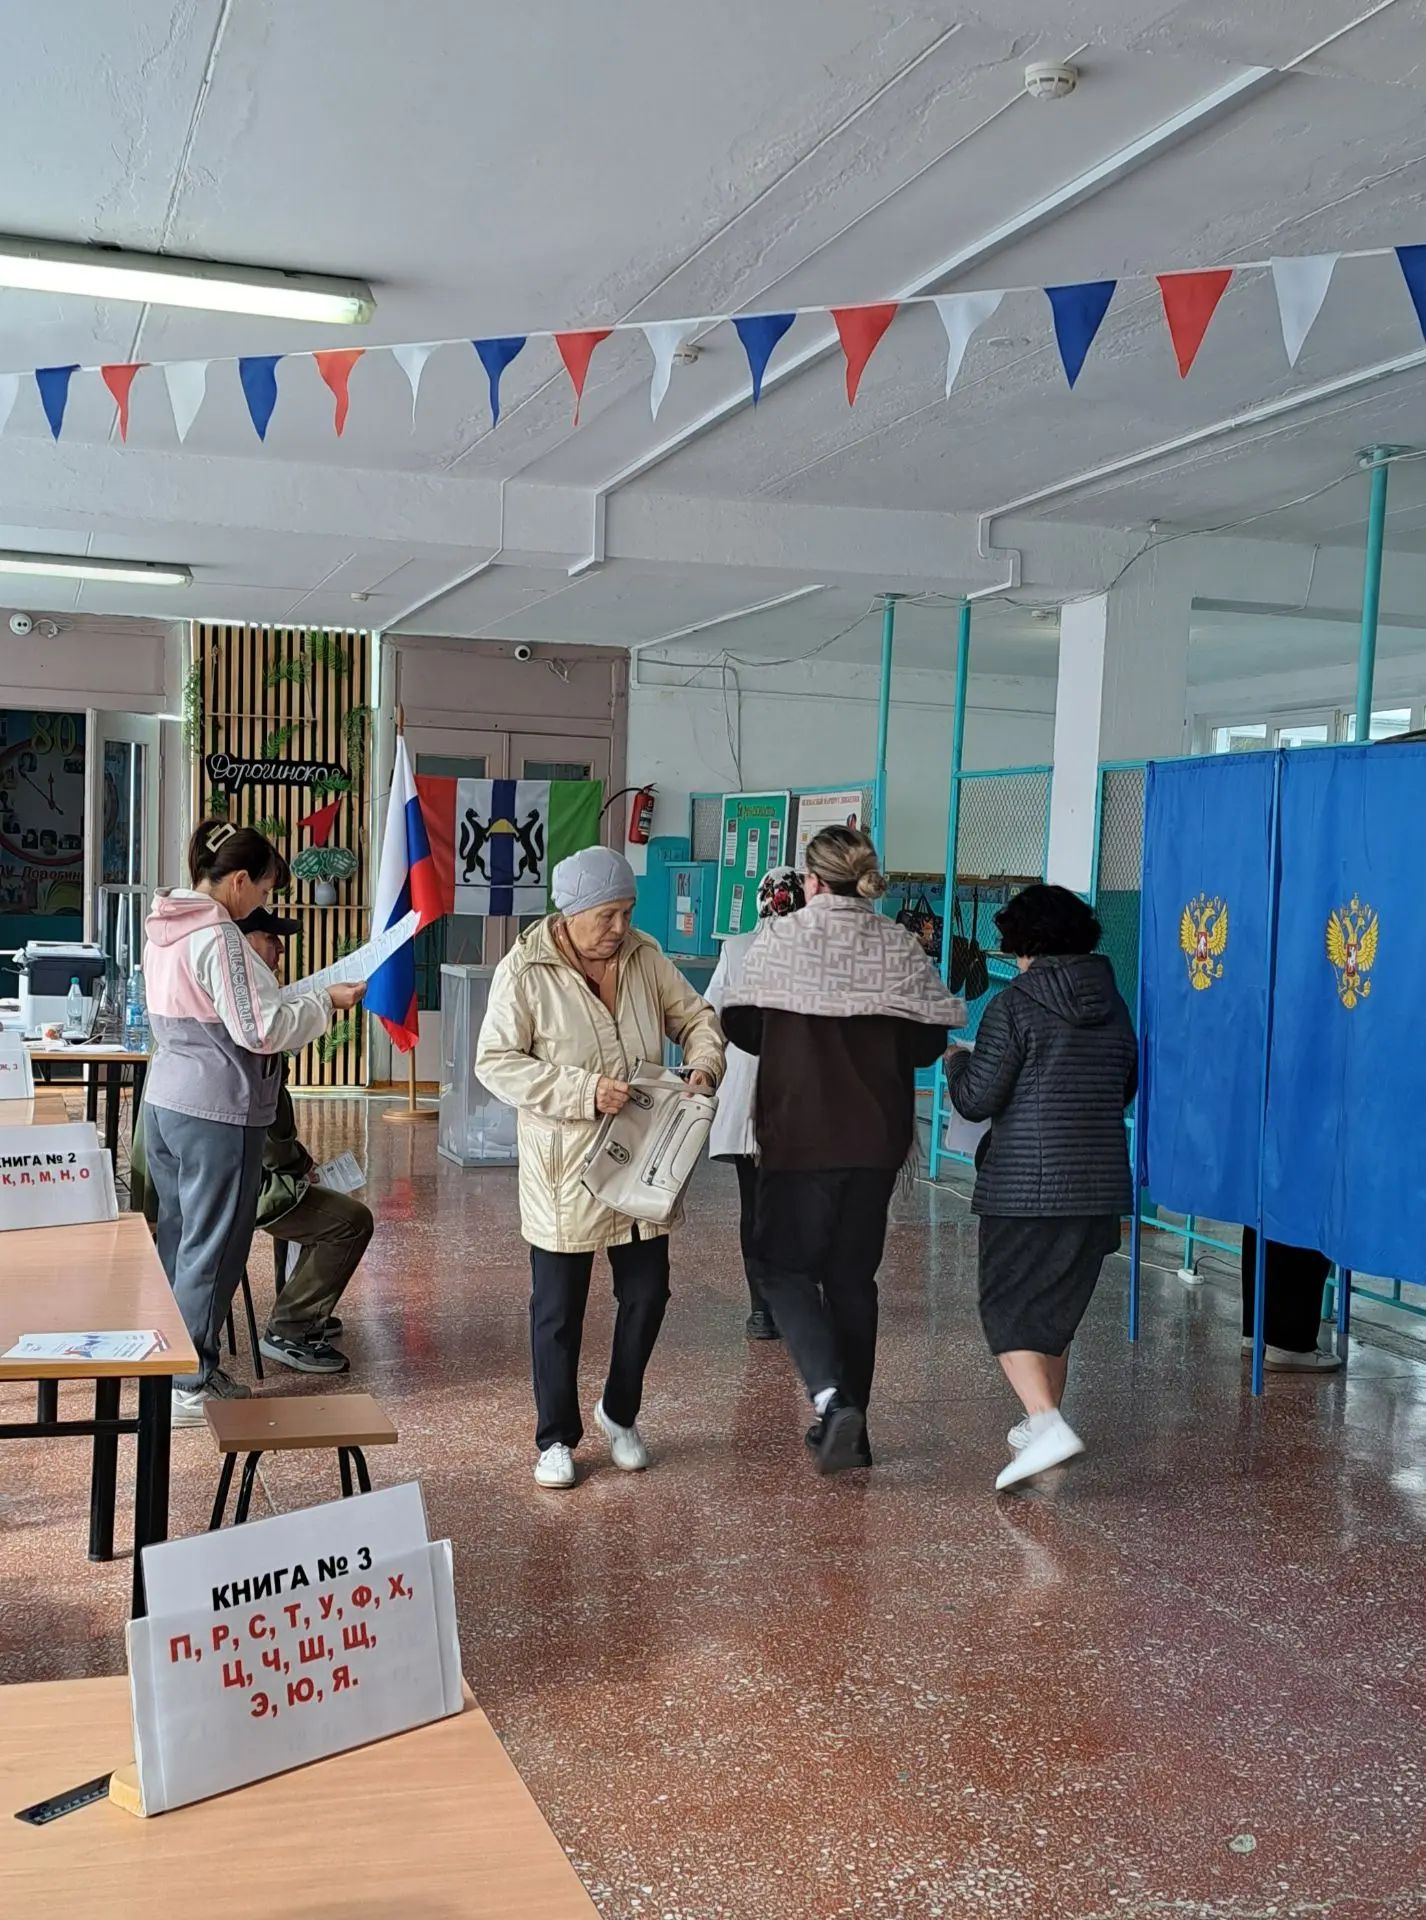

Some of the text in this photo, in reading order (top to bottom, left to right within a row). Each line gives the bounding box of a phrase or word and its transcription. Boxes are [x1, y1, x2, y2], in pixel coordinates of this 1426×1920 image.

[32, 714, 76, 757] 80
[233, 984, 255, 1032] GIRLS
[2, 1167, 90, 1187] К, Л, М, Н, О
[46, 1153, 63, 1166] №
[67, 1152, 77, 1164] 2
[212, 1547, 373, 1611] КНИГА № 3
[169, 1573, 414, 1663] П, Р, С, Т, У, Ф, Х,
[223, 1621, 377, 1688] Ц, Ч, Ш, Щ,
[250, 1665, 359, 1718] Э, Ю, Я.
